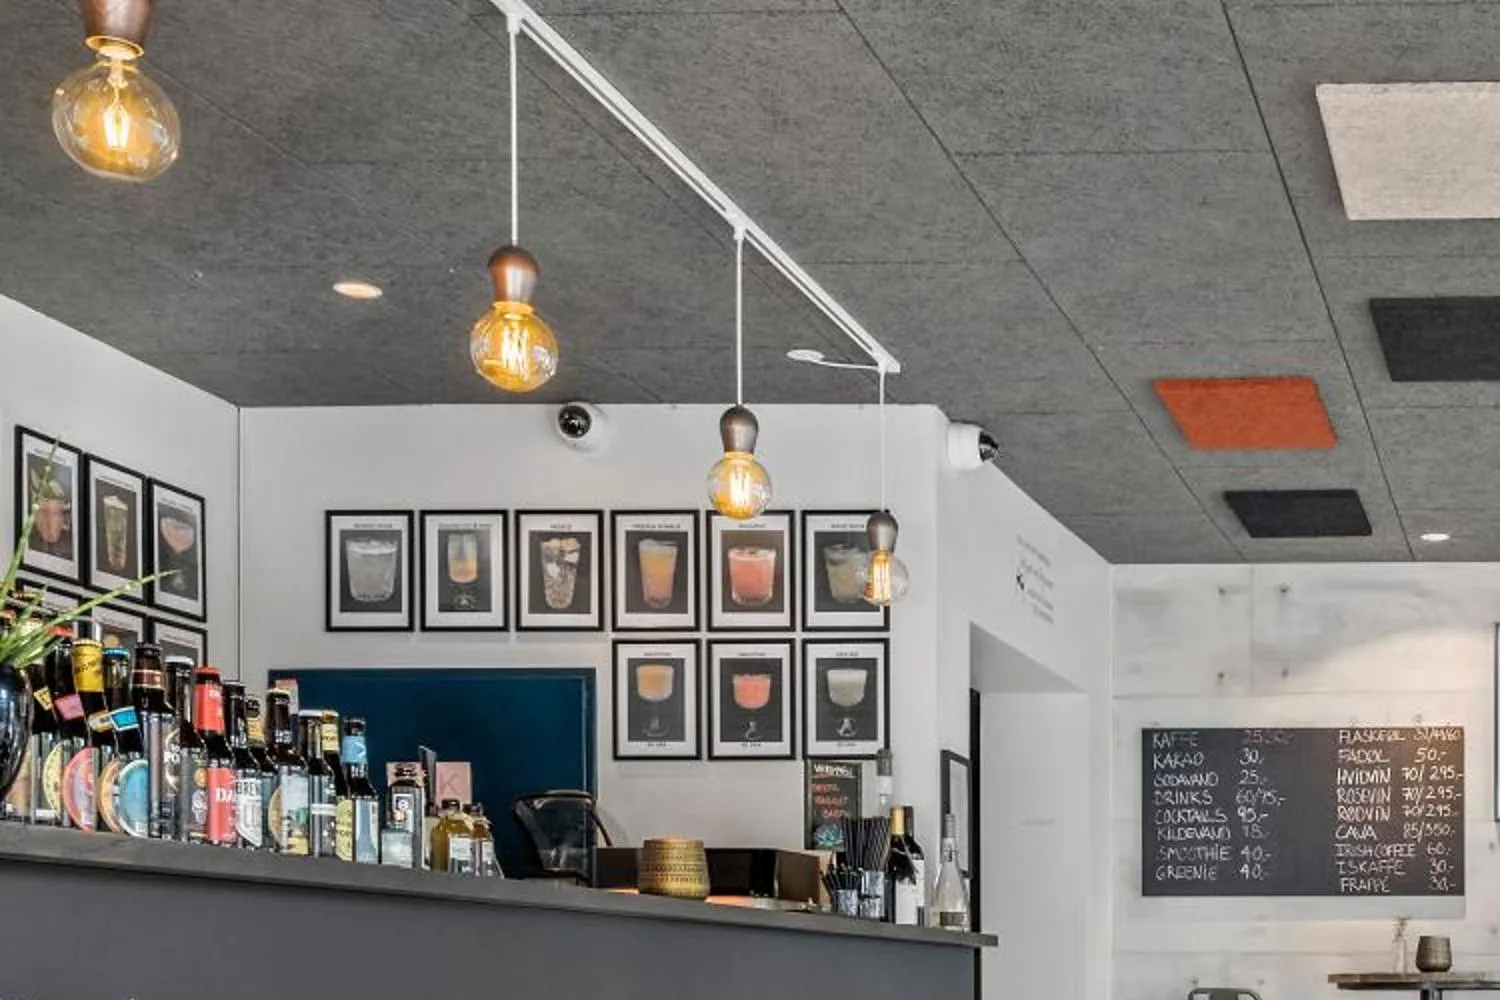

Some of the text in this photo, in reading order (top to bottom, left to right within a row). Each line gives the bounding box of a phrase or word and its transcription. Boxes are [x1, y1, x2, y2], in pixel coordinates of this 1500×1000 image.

[1153, 732, 1199, 748] KAFFE
[1153, 752, 1205, 770] KAKAO
[1153, 772, 1219, 787] SODAVAND
[1337, 767, 1391, 785] HVIDVIN
[1154, 789, 1213, 805] DRINKS
[1154, 808, 1228, 824] COCKTAILS
[1336, 824, 1378, 841] CAVA
[1157, 844, 1232, 861] SMOOTHIE
[1156, 864, 1217, 881] GREENIE
[1336, 859, 1406, 875] ISKAFFE
